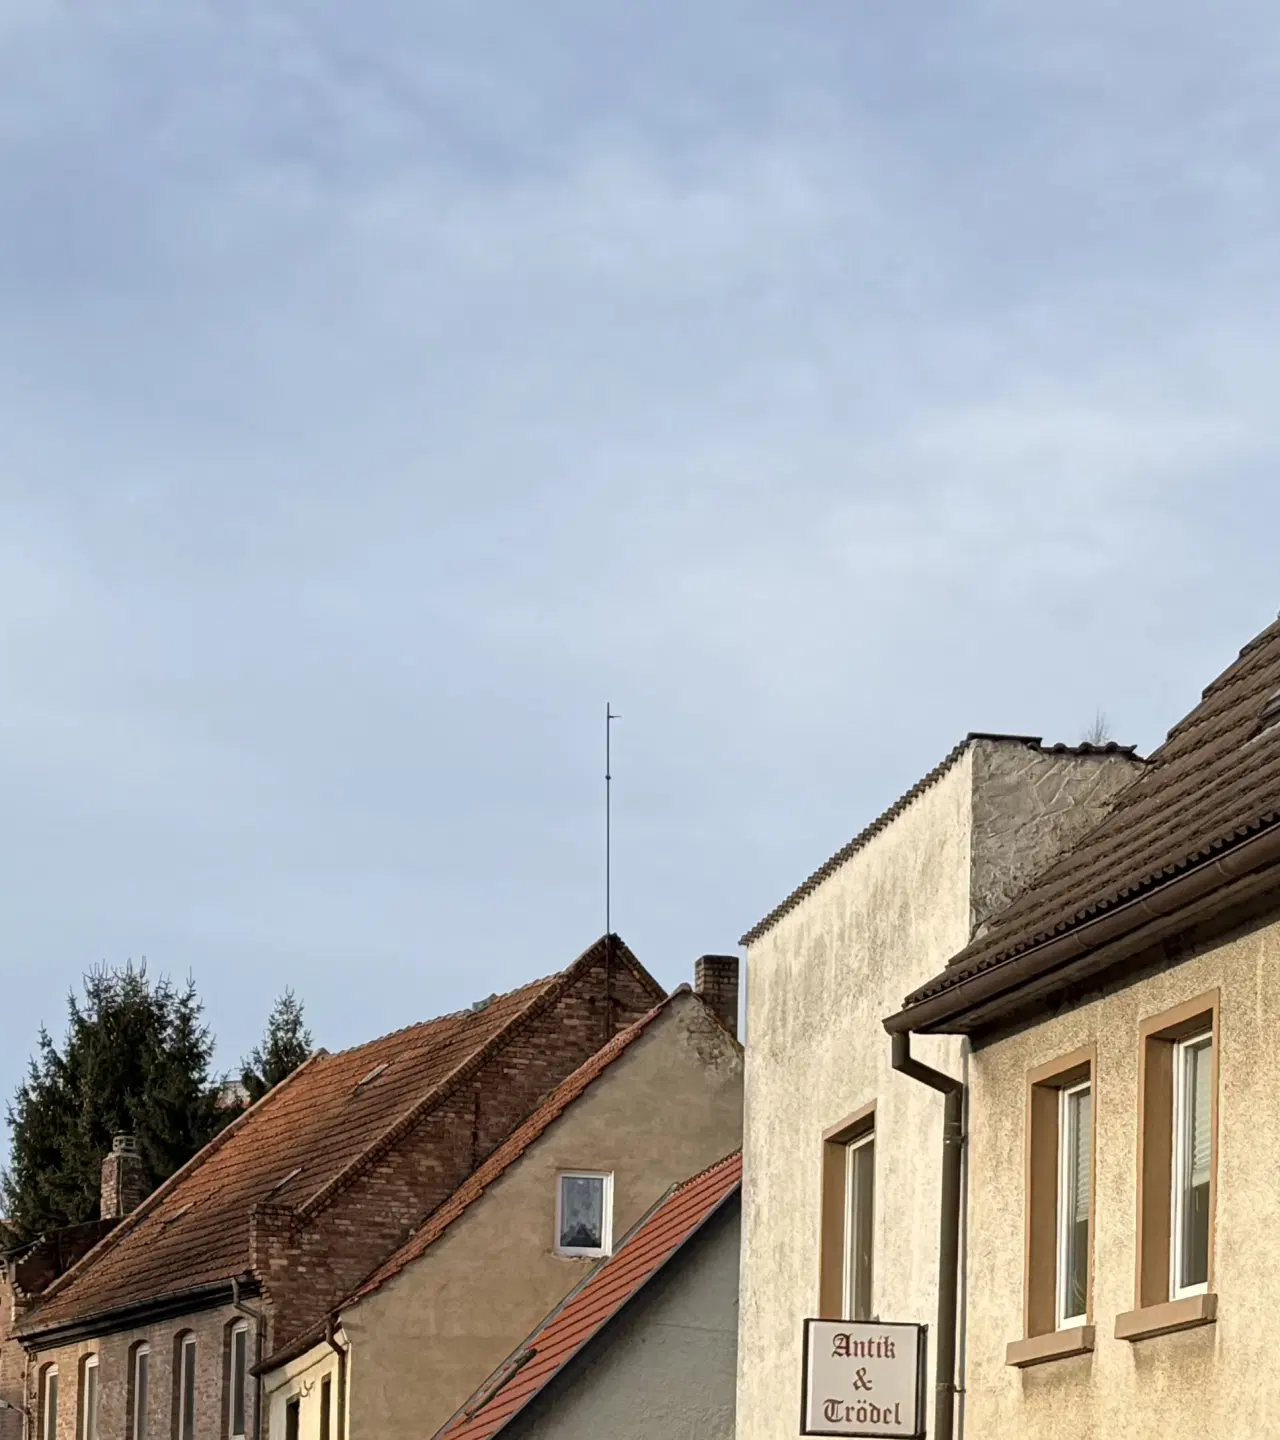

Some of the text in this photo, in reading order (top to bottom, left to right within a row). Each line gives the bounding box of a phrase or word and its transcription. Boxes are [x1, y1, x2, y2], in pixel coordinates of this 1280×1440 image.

[831, 1333, 896, 1359] Antik
[853, 1367, 873, 1391] &
[823, 1398, 902, 1426] Trödel
